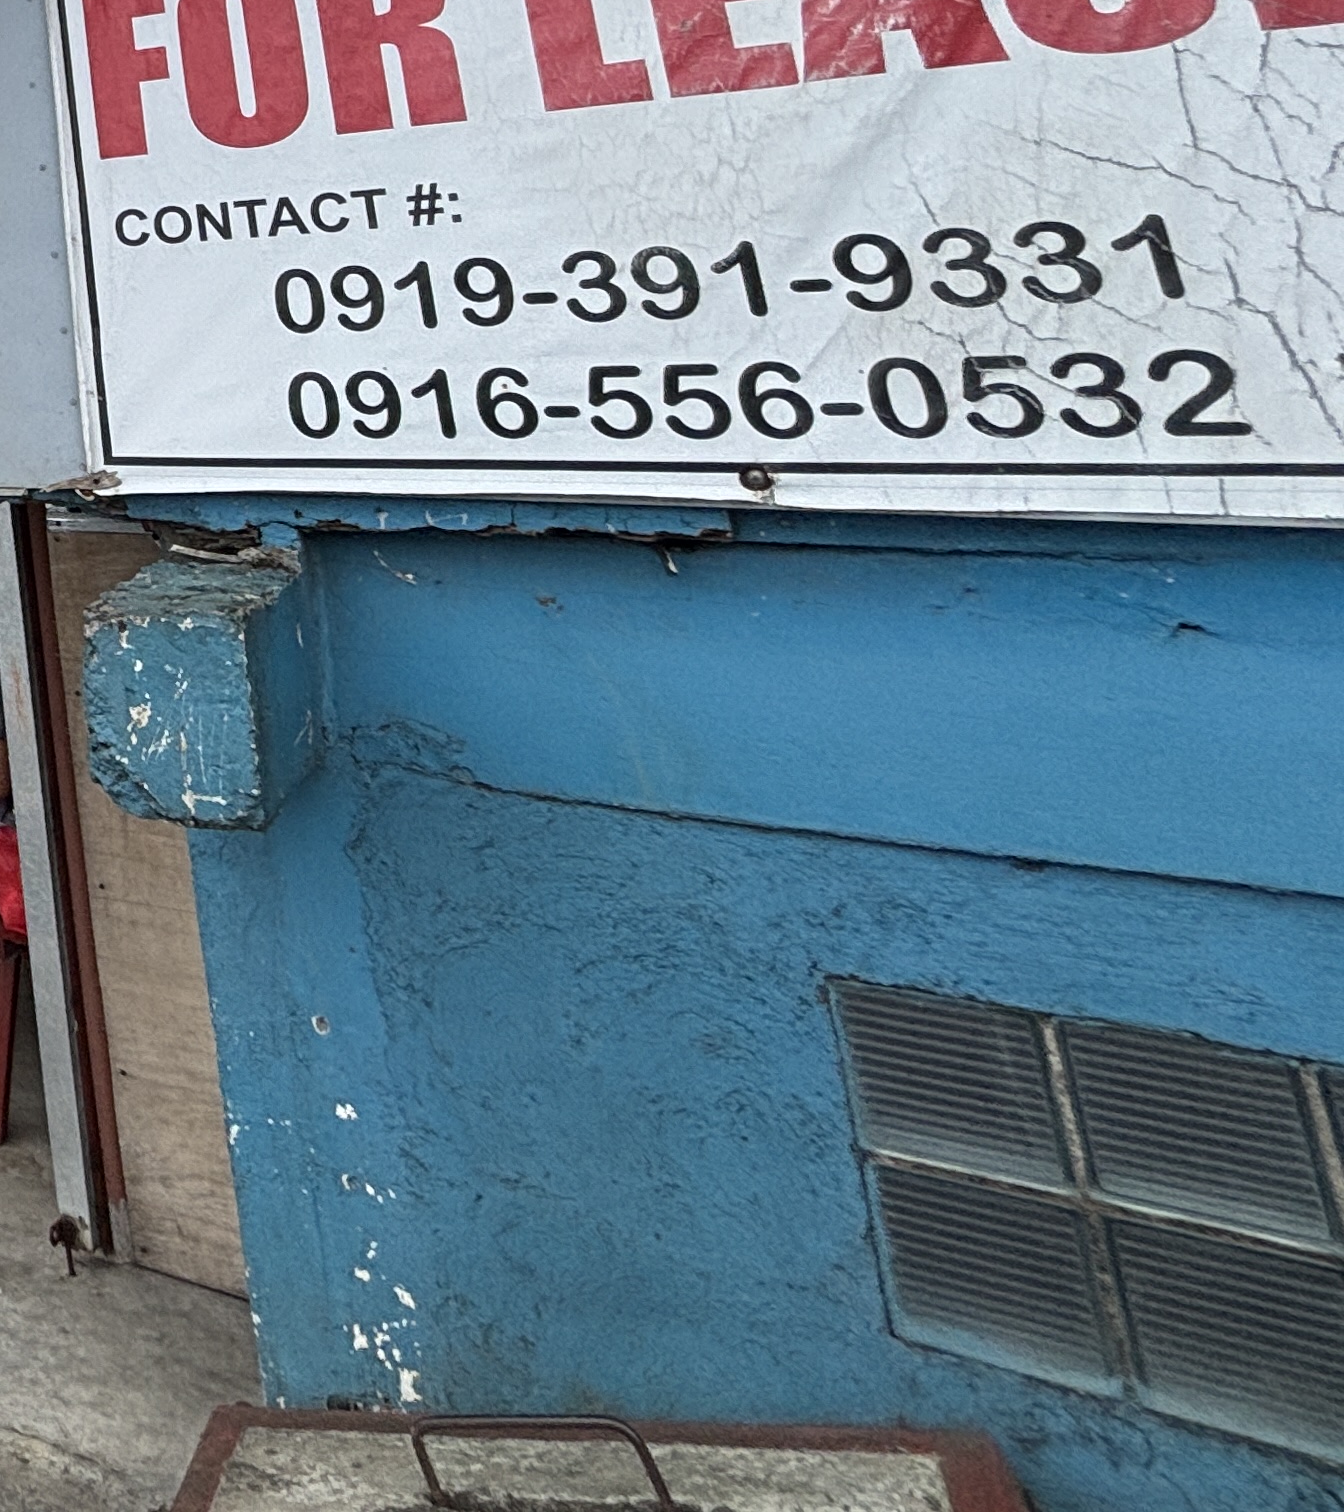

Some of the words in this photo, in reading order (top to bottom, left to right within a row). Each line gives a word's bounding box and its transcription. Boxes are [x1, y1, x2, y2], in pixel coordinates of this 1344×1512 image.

[114, 187, 388, 247] CONTACT
[406, 183, 463, 226] #:
[273, 213, 1186, 334] 0919-391-9331
[286, 348, 1254, 440] 0916-556-0532
